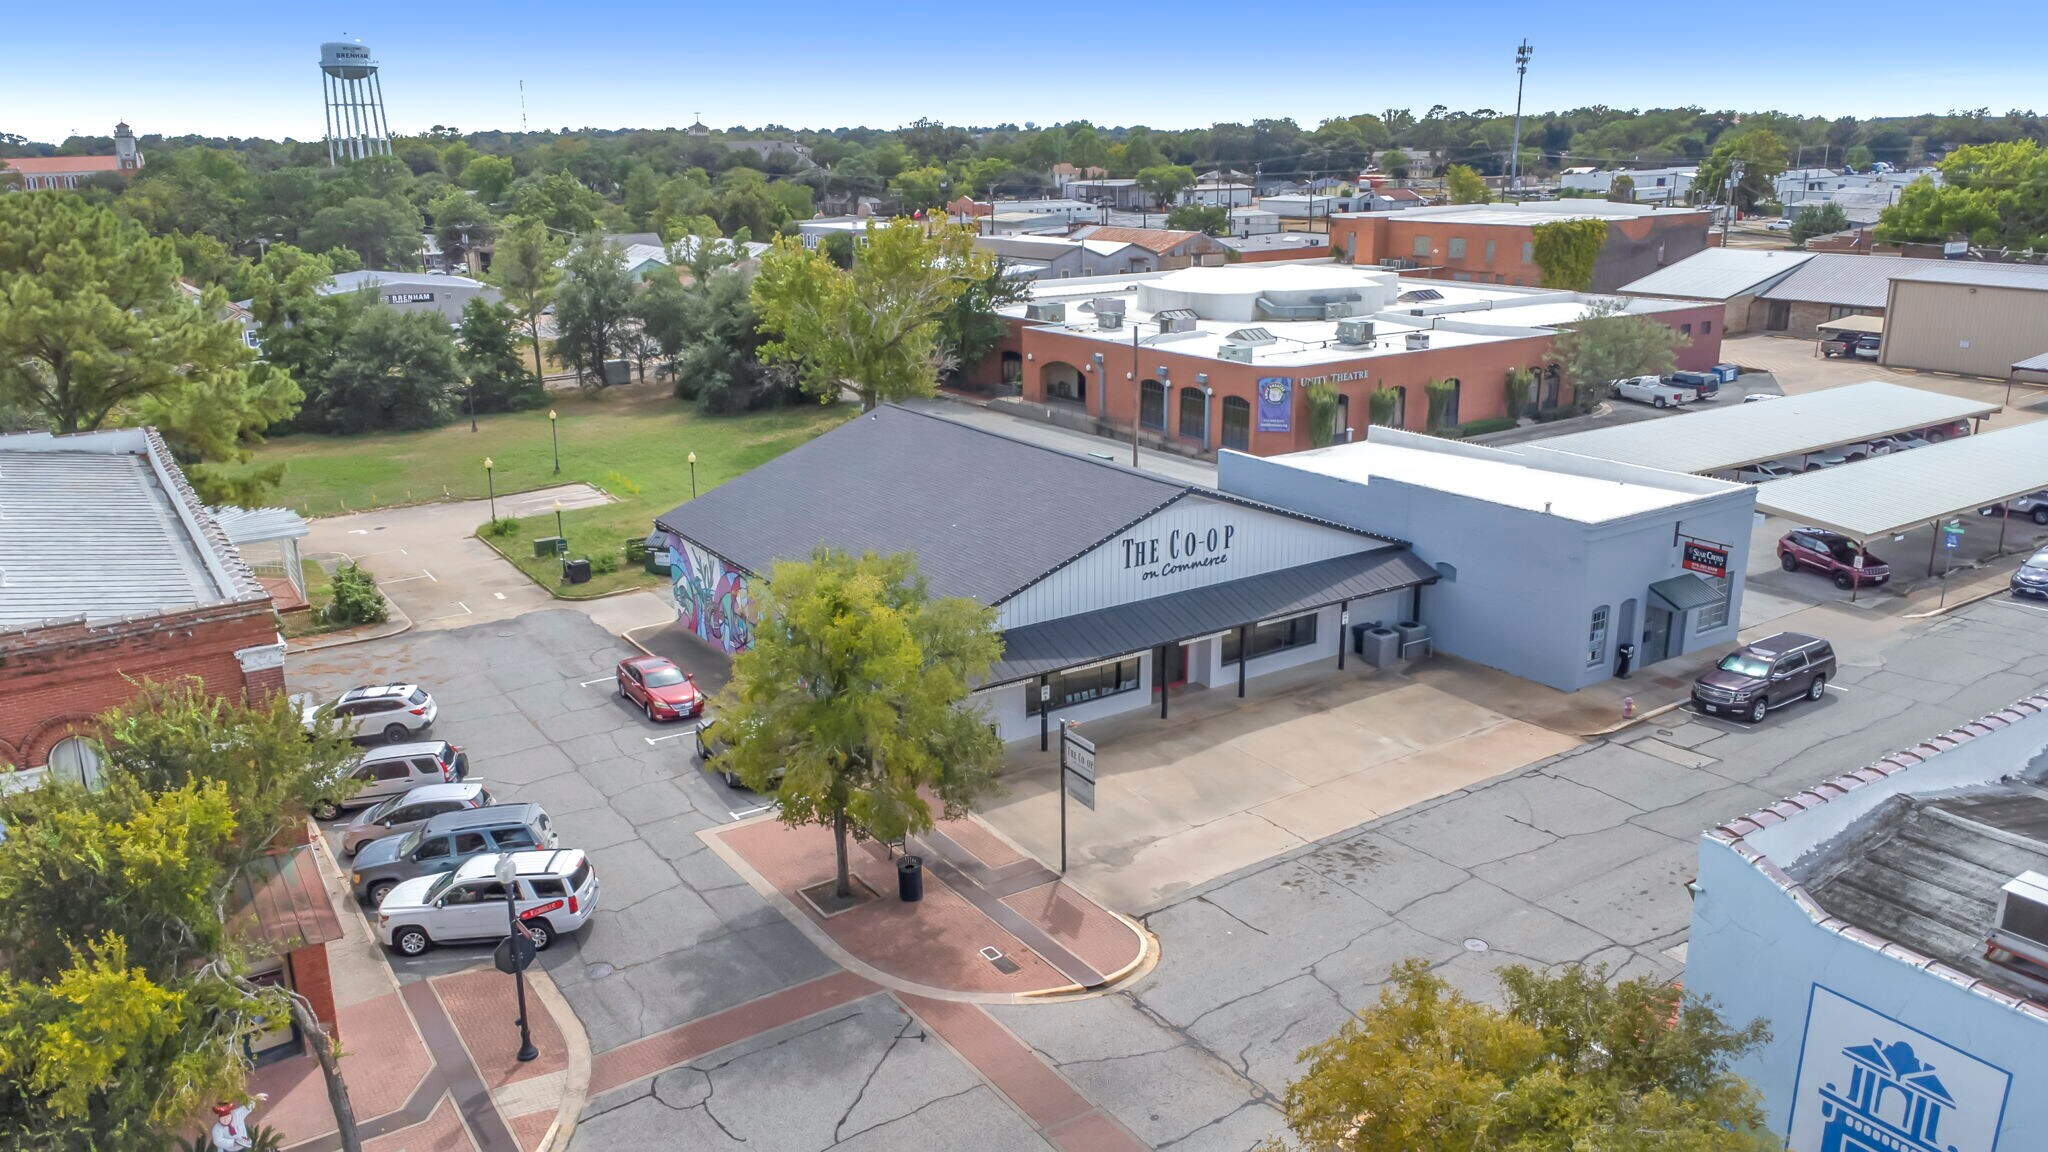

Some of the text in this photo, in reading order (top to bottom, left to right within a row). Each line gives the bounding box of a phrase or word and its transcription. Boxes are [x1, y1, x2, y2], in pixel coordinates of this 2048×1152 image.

[392, 293, 430, 301] BRENHAM
[1300, 370, 1369, 387] UNITY THEATRE
[1122, 525, 1234, 569] THE CO-OP
[1142, 554, 1228, 581] on Commerce
